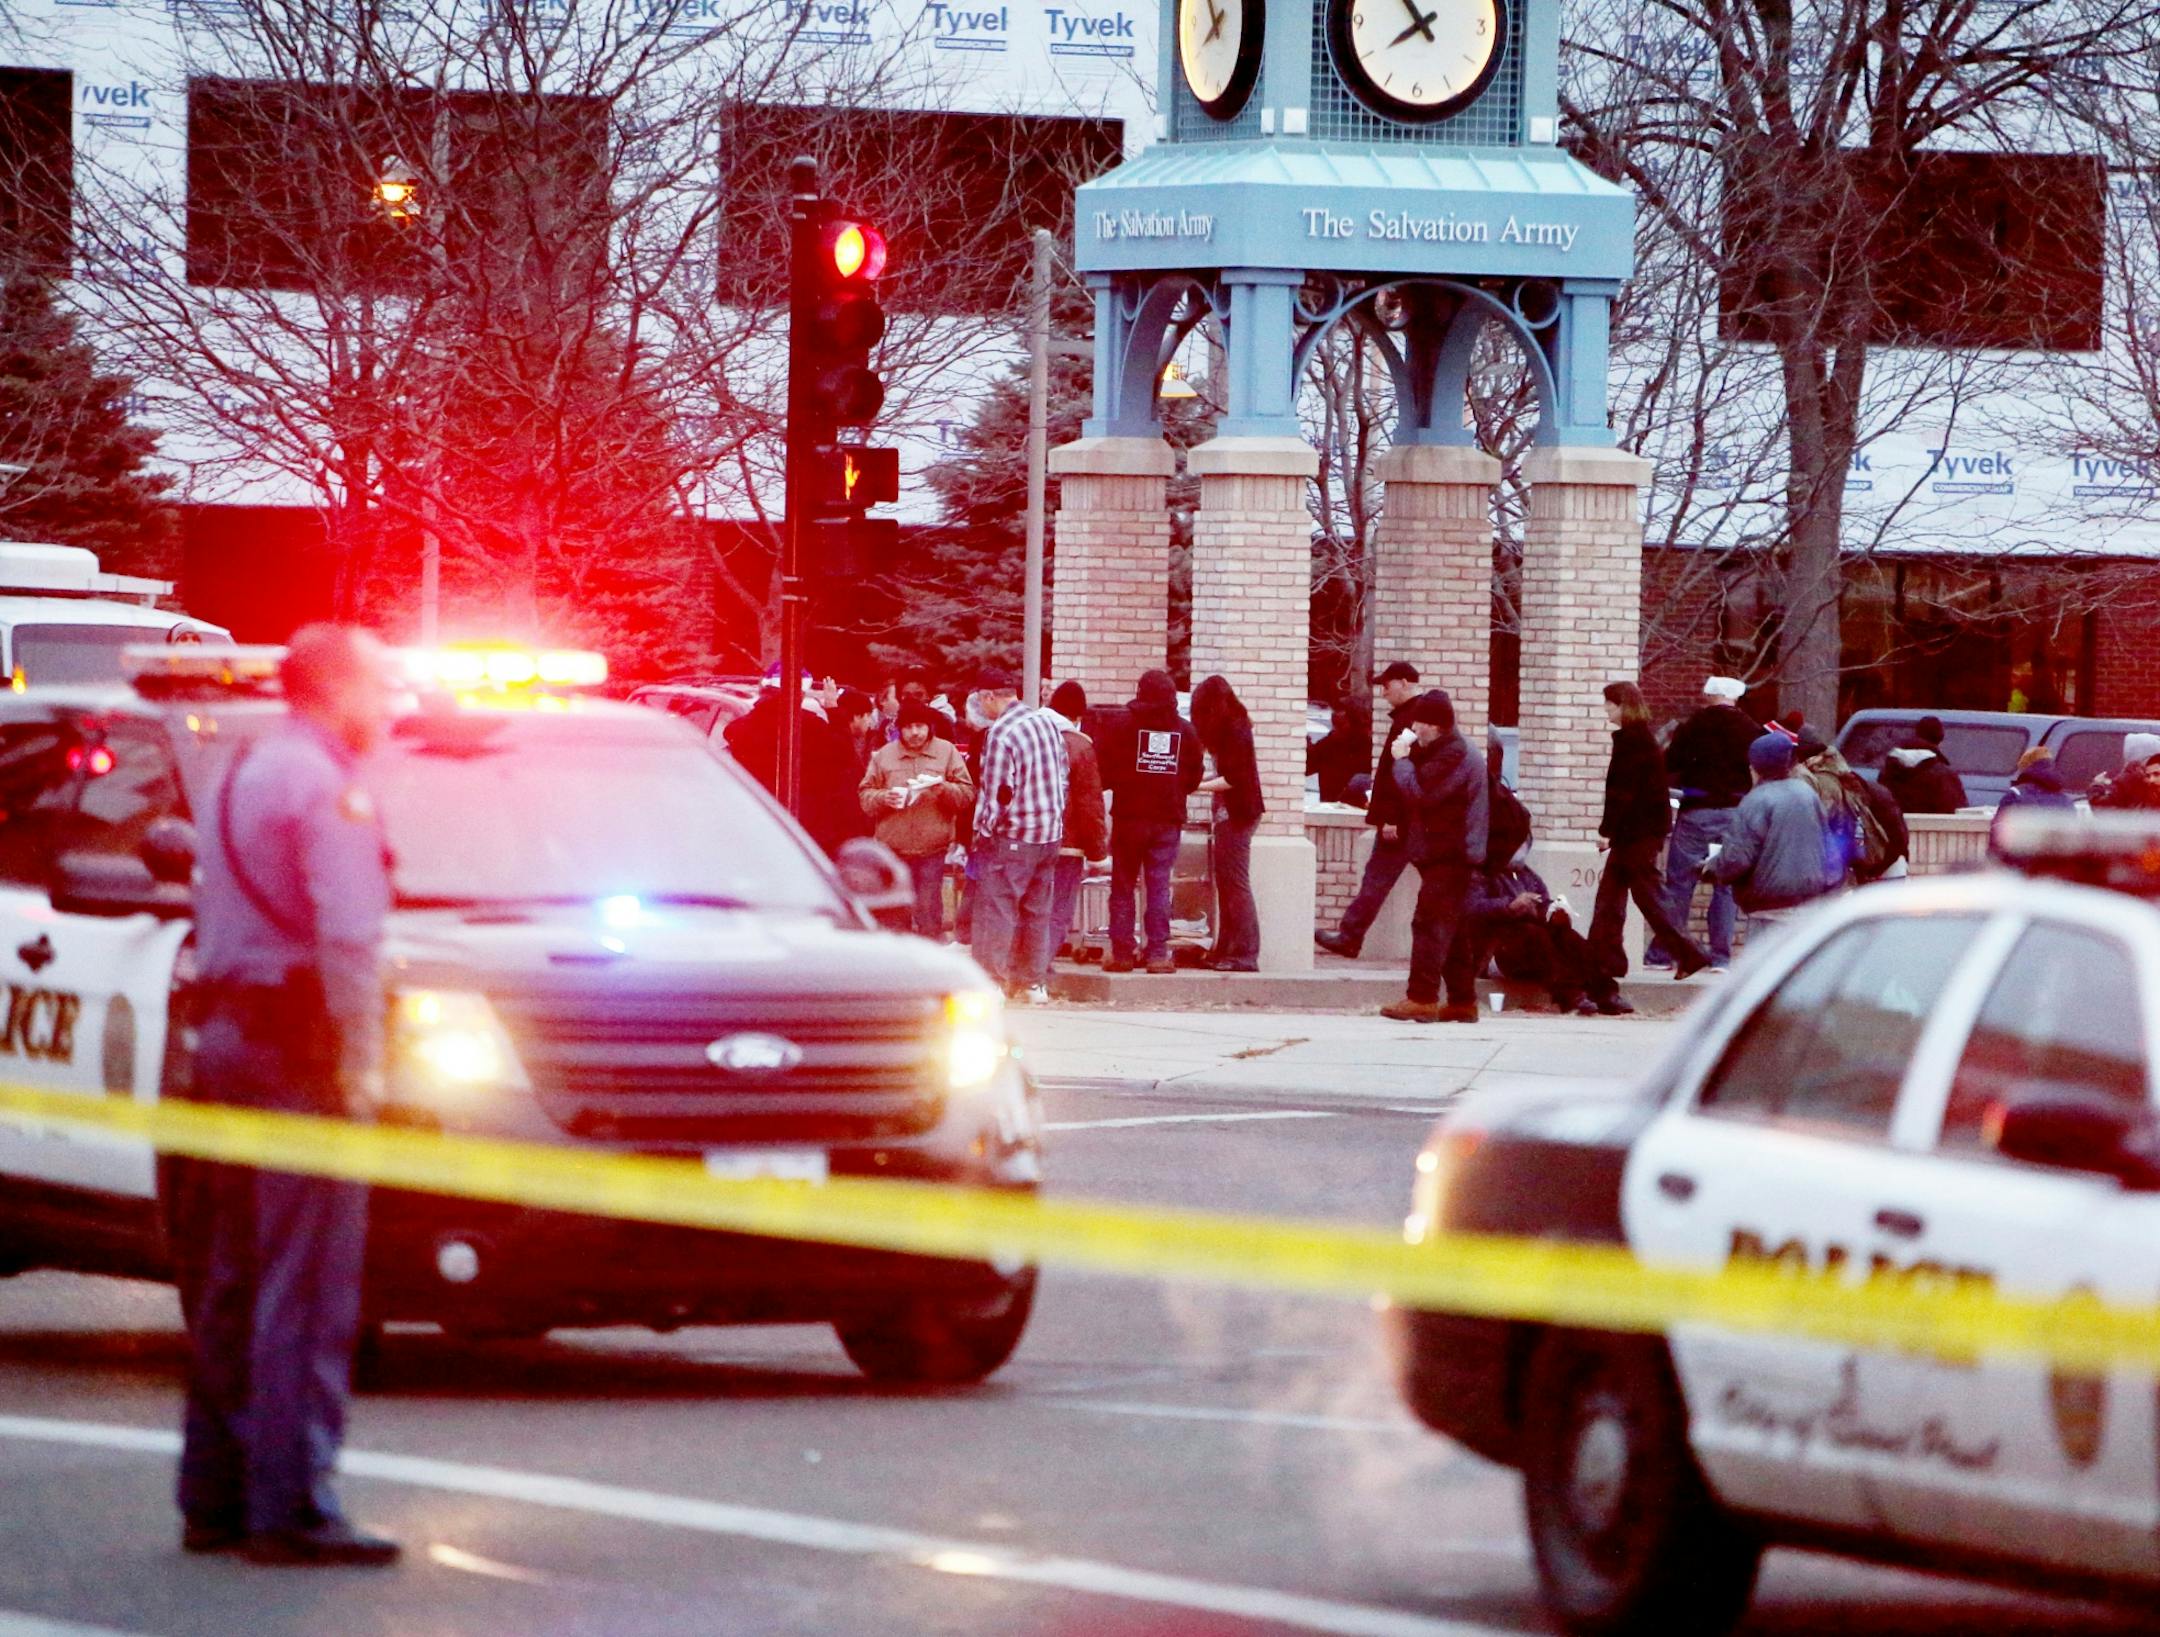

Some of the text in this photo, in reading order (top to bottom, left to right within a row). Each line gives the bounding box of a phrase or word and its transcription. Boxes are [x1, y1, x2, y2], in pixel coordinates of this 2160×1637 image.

[1044, 9, 1134, 41] Tyvek
[1353, 14, 1364, 30] 9
[1476, 18, 1487, 36] 3
[1411, 81, 1423, 98] 6
[1093, 209, 1214, 242] The Salvation Army
[1303, 207, 1580, 251] The Salvation Army
[1927, 450, 2013, 480] Tyvek
[0, 984, 80, 1064] ICE
